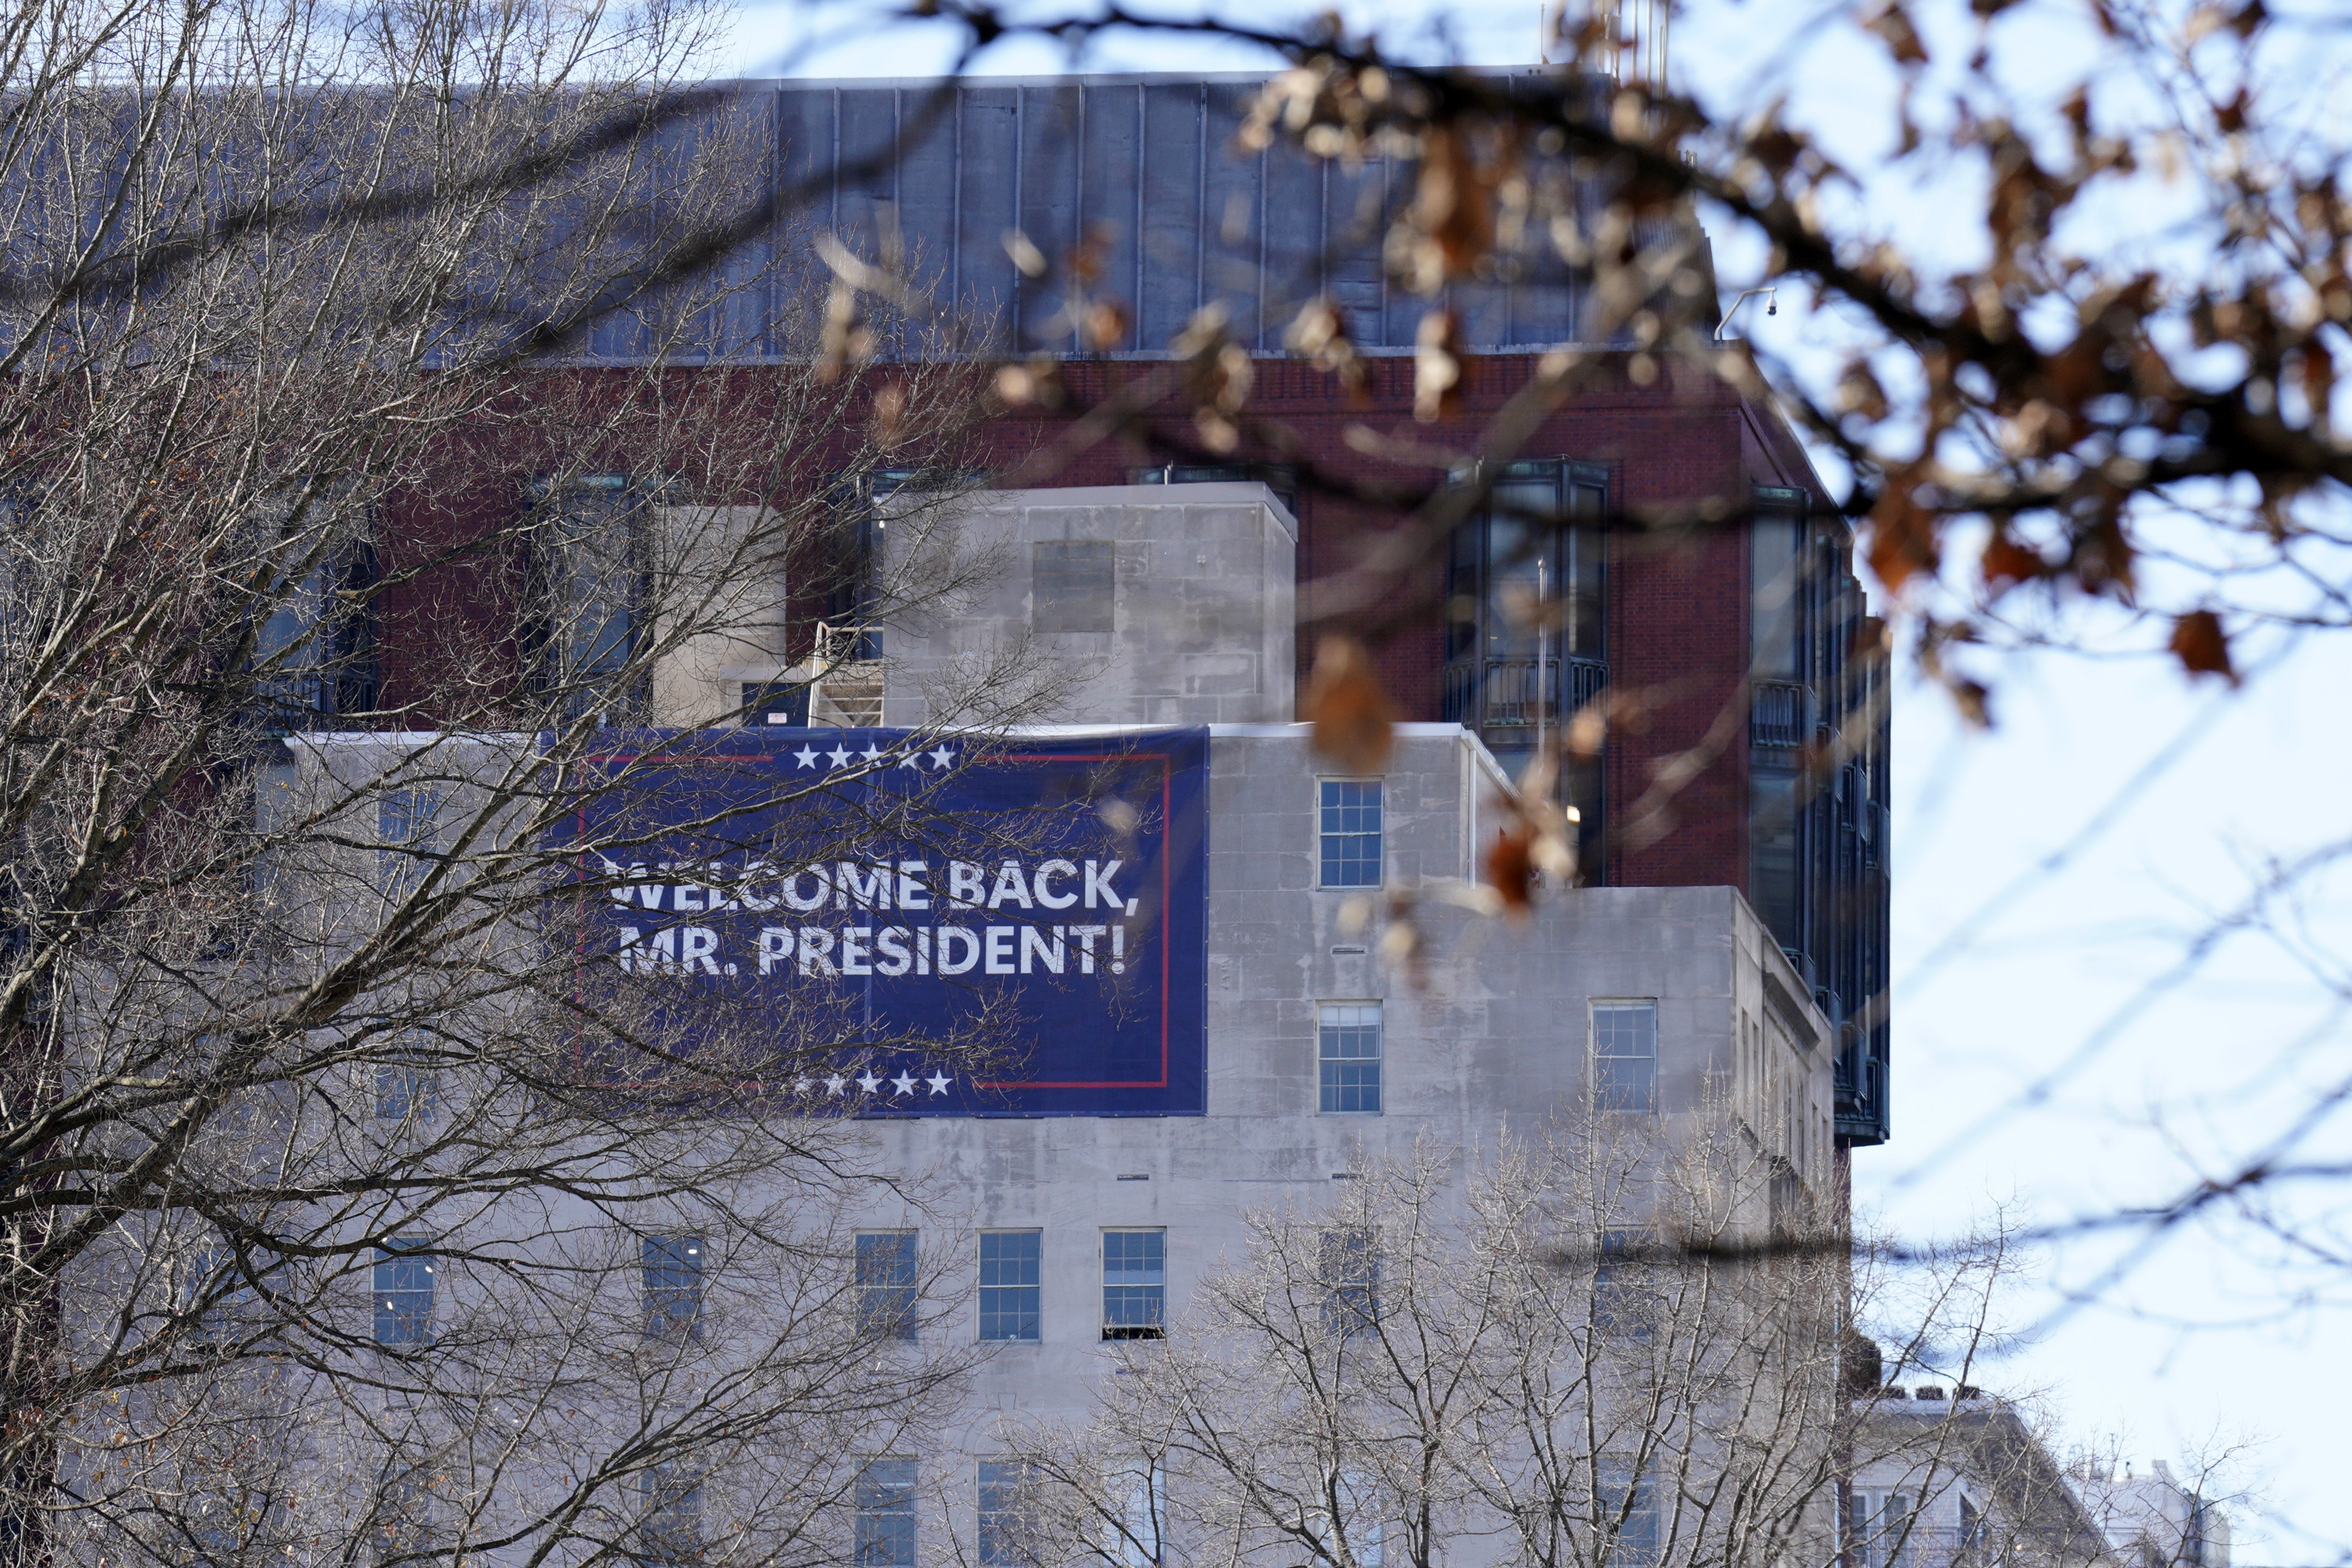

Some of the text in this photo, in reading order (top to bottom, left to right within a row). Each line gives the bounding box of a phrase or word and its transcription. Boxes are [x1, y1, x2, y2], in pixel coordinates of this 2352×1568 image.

[603, 859, 1139, 916] WELCOME BACK,
[620, 925, 1125, 975] MR. PRESIDENT!
